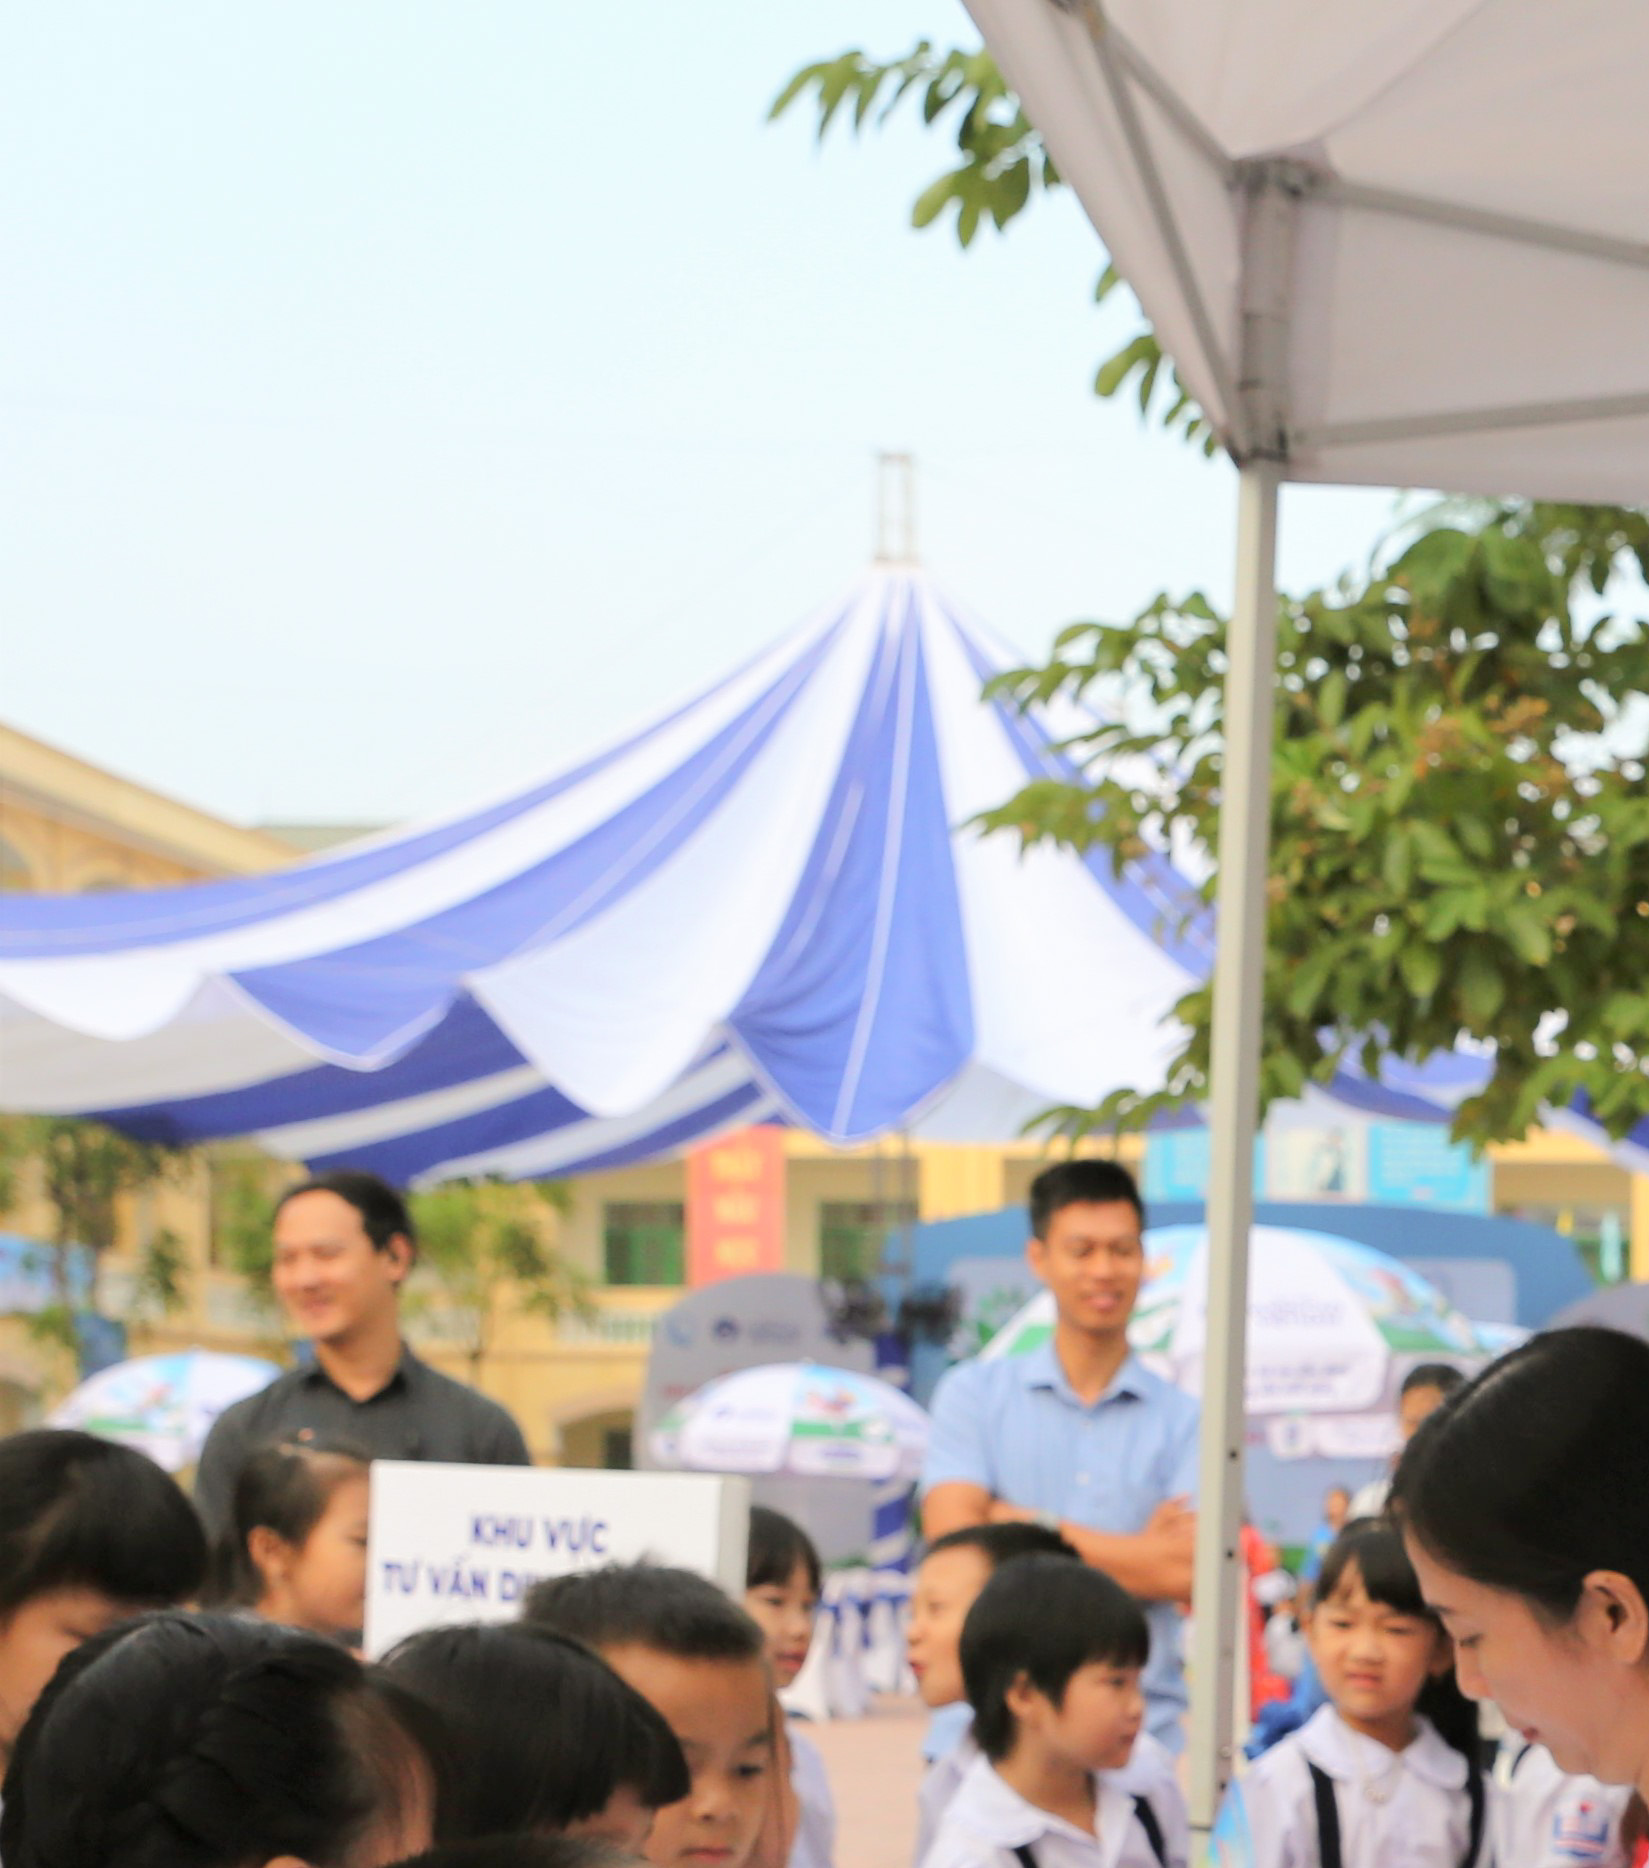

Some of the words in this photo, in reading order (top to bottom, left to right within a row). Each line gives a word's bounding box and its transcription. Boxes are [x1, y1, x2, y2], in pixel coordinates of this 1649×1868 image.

[471, 1514, 533, 1548] KHU
[543, 1516, 609, 1557] VỰC
[382, 1559, 421, 1594] TƯ
